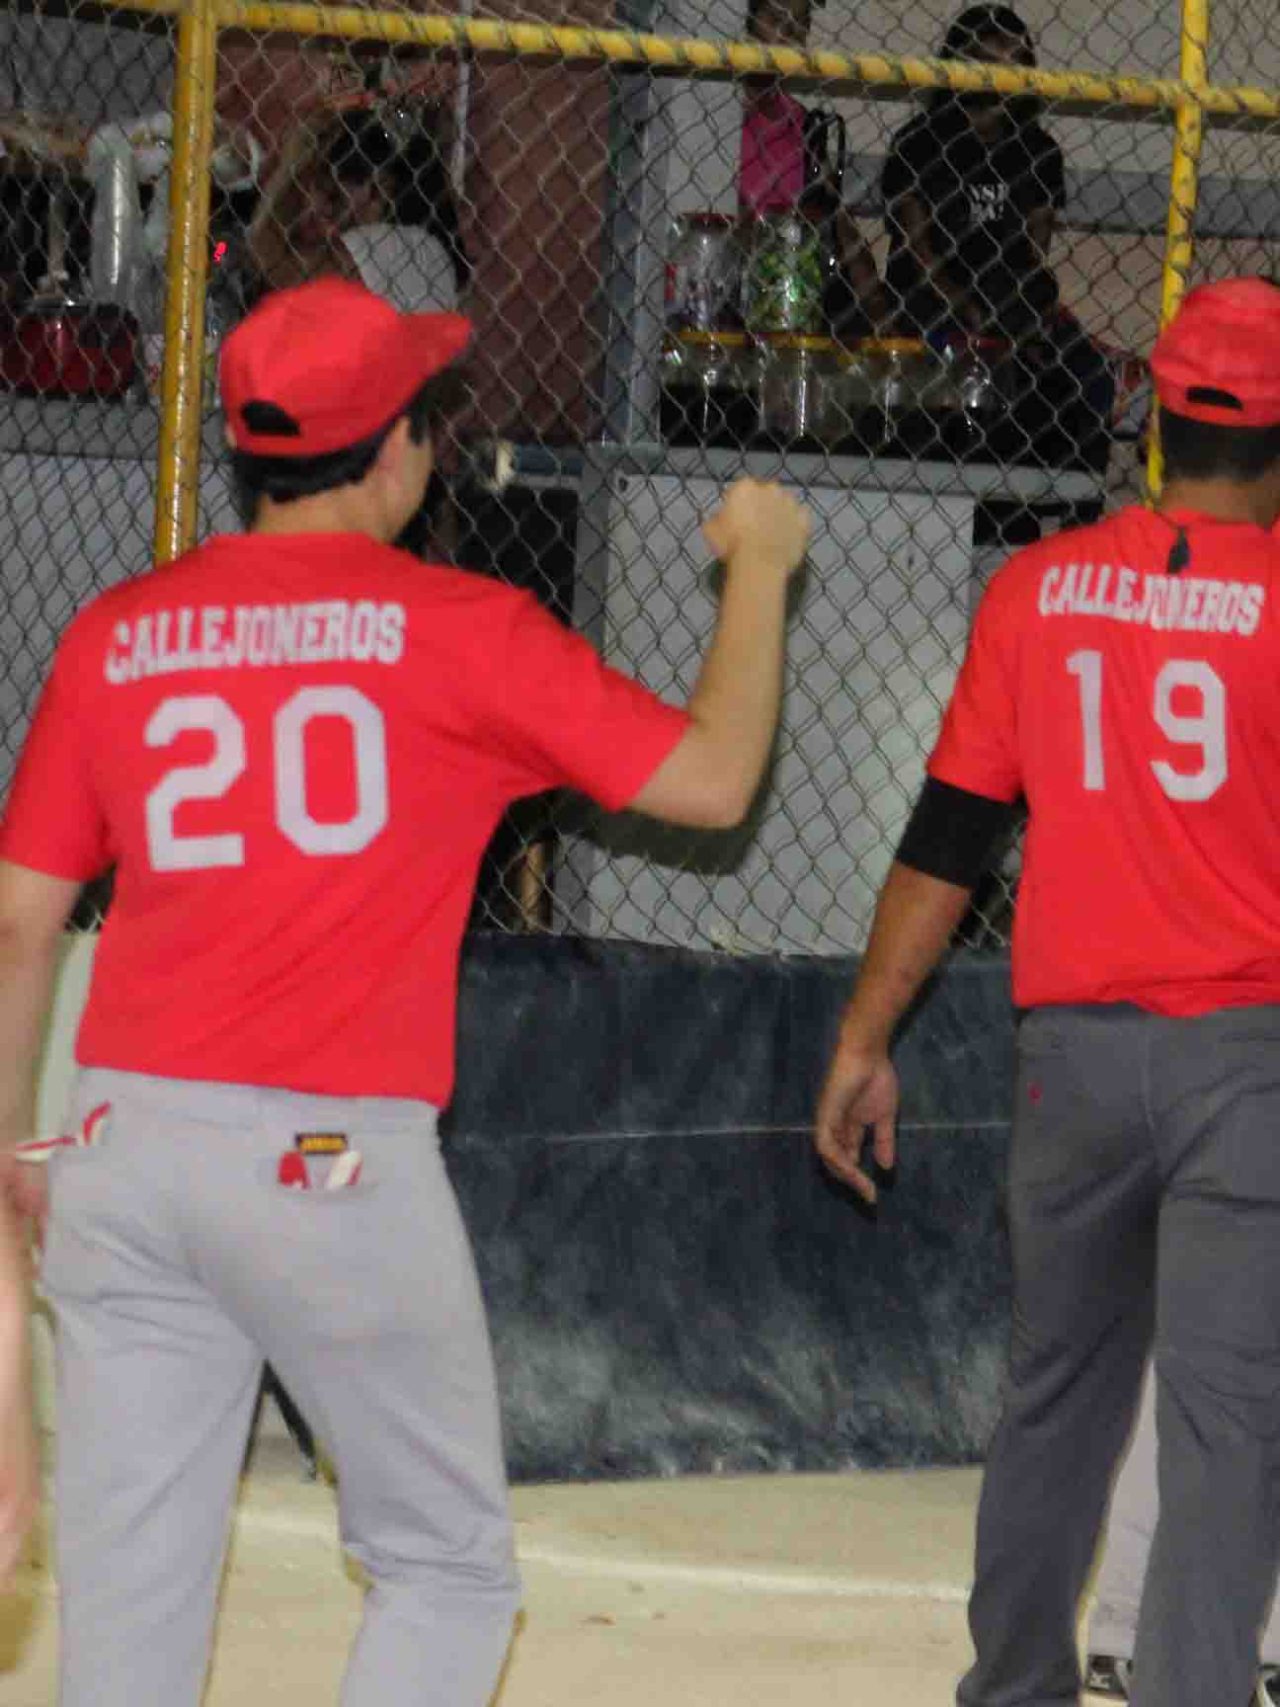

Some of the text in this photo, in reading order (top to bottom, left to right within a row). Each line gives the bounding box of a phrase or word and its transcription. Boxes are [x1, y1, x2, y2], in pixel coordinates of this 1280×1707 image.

[105, 599, 406, 685] CALLEJONEROS
[144, 684, 389, 872] 20
[1066, 648, 1228, 803] 19
